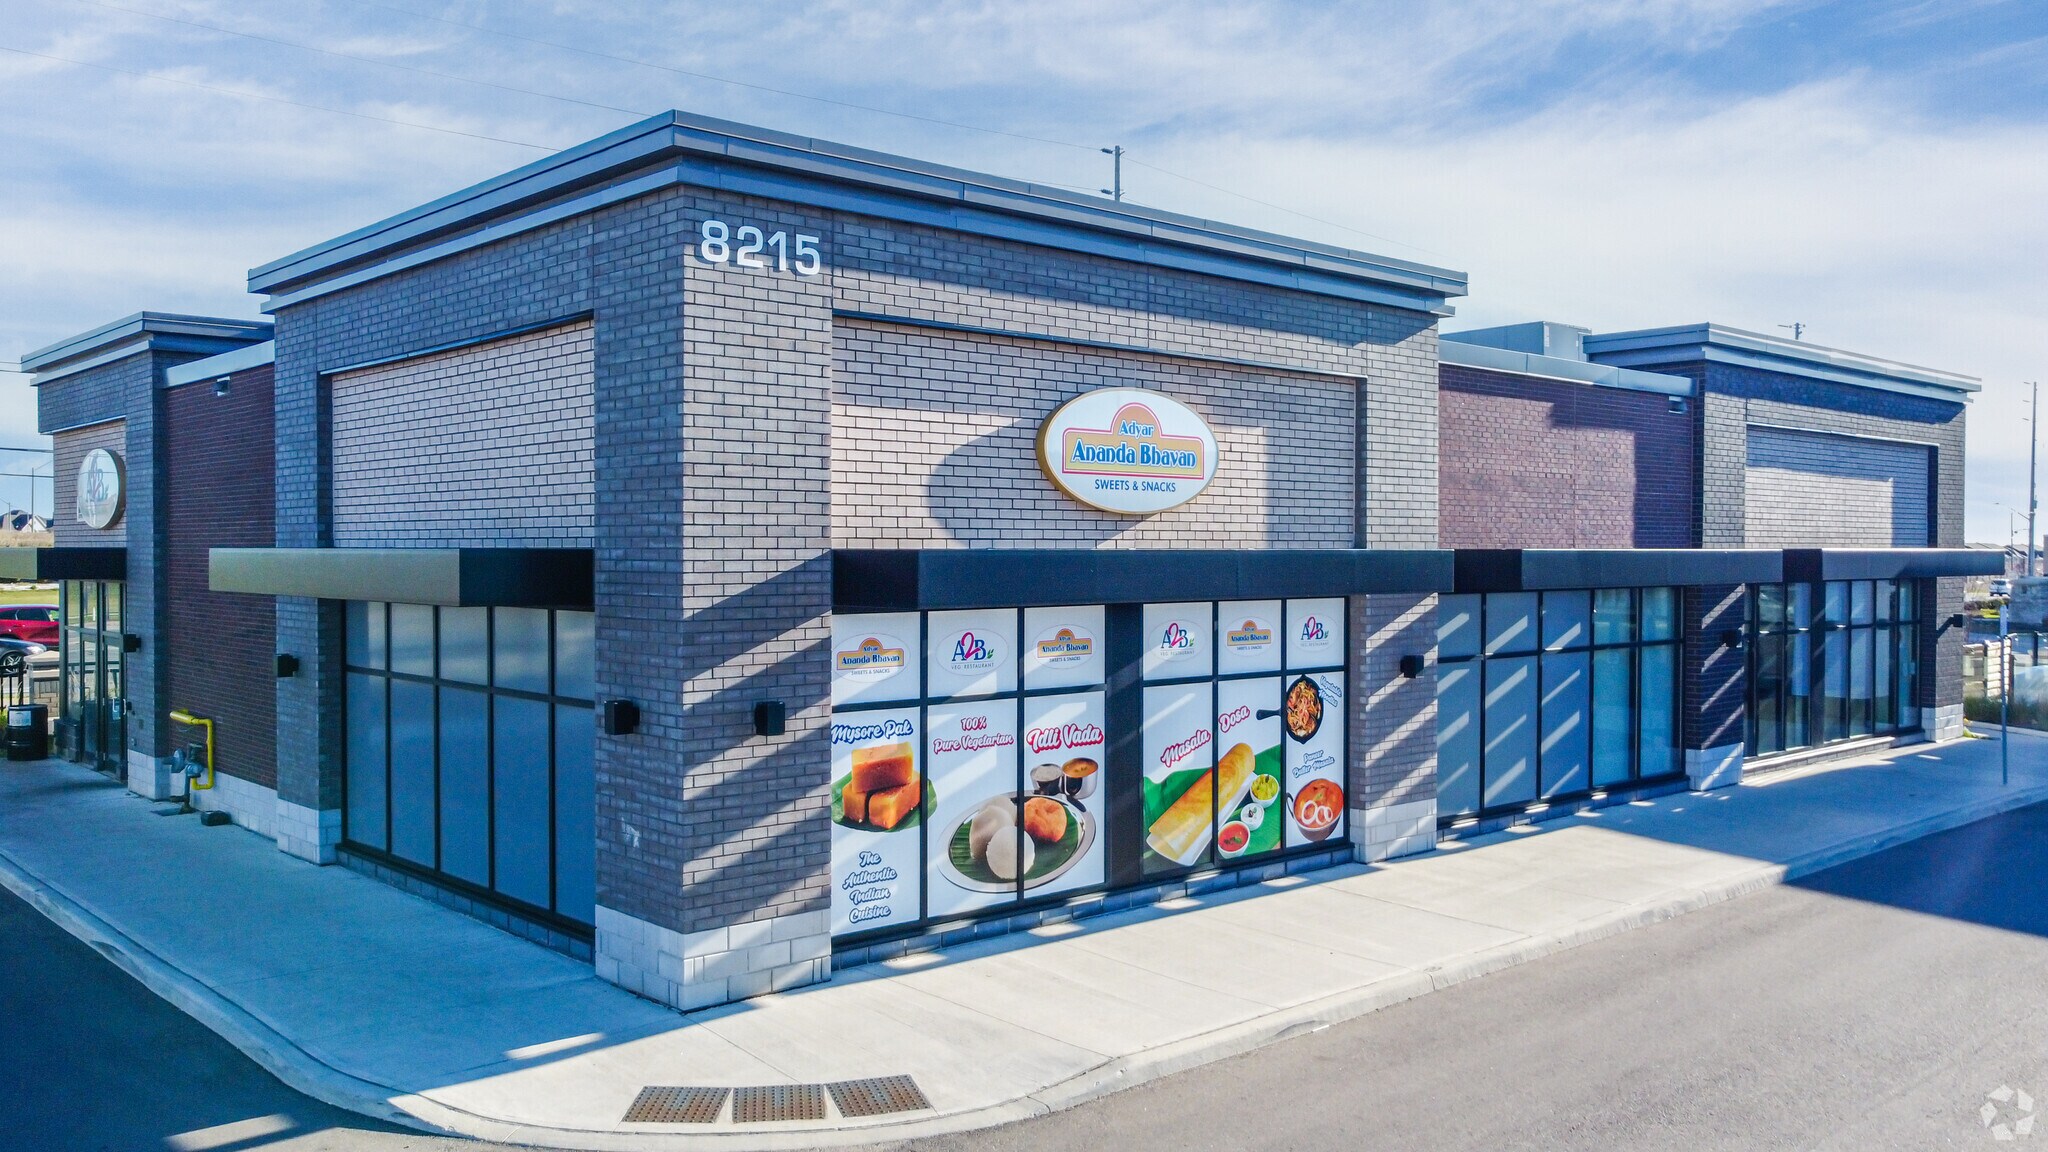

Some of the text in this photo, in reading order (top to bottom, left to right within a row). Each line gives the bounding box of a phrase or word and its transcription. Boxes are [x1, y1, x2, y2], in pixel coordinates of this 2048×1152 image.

[701, 220, 820, 275] 8215
[1119, 419, 1154, 439] Adyar
[1071, 438, 1197, 468] Ananda Bhavan
[1094, 479, 1176, 492] SWEETS & SNACKS
[1161, 622, 1188, 648] A2B
[1300, 616, 1324, 640] A2B
[951, 631, 987, 661] A2B
[842, 653, 900, 665] Ananda Bhavan
[831, 719, 914, 744] Mysore Pak
[961, 716, 987, 731] 100%
[933, 733, 1014, 755] Pure Vegetarian
[1026, 723, 1104, 753] Idli Vada
[1160, 705, 1250, 767] Masala Dosa
[859, 851, 882, 867] The
[842, 866, 897, 890] Authentic
[849, 887, 891, 905] Indian
[849, 905, 891, 924] Cuisine
